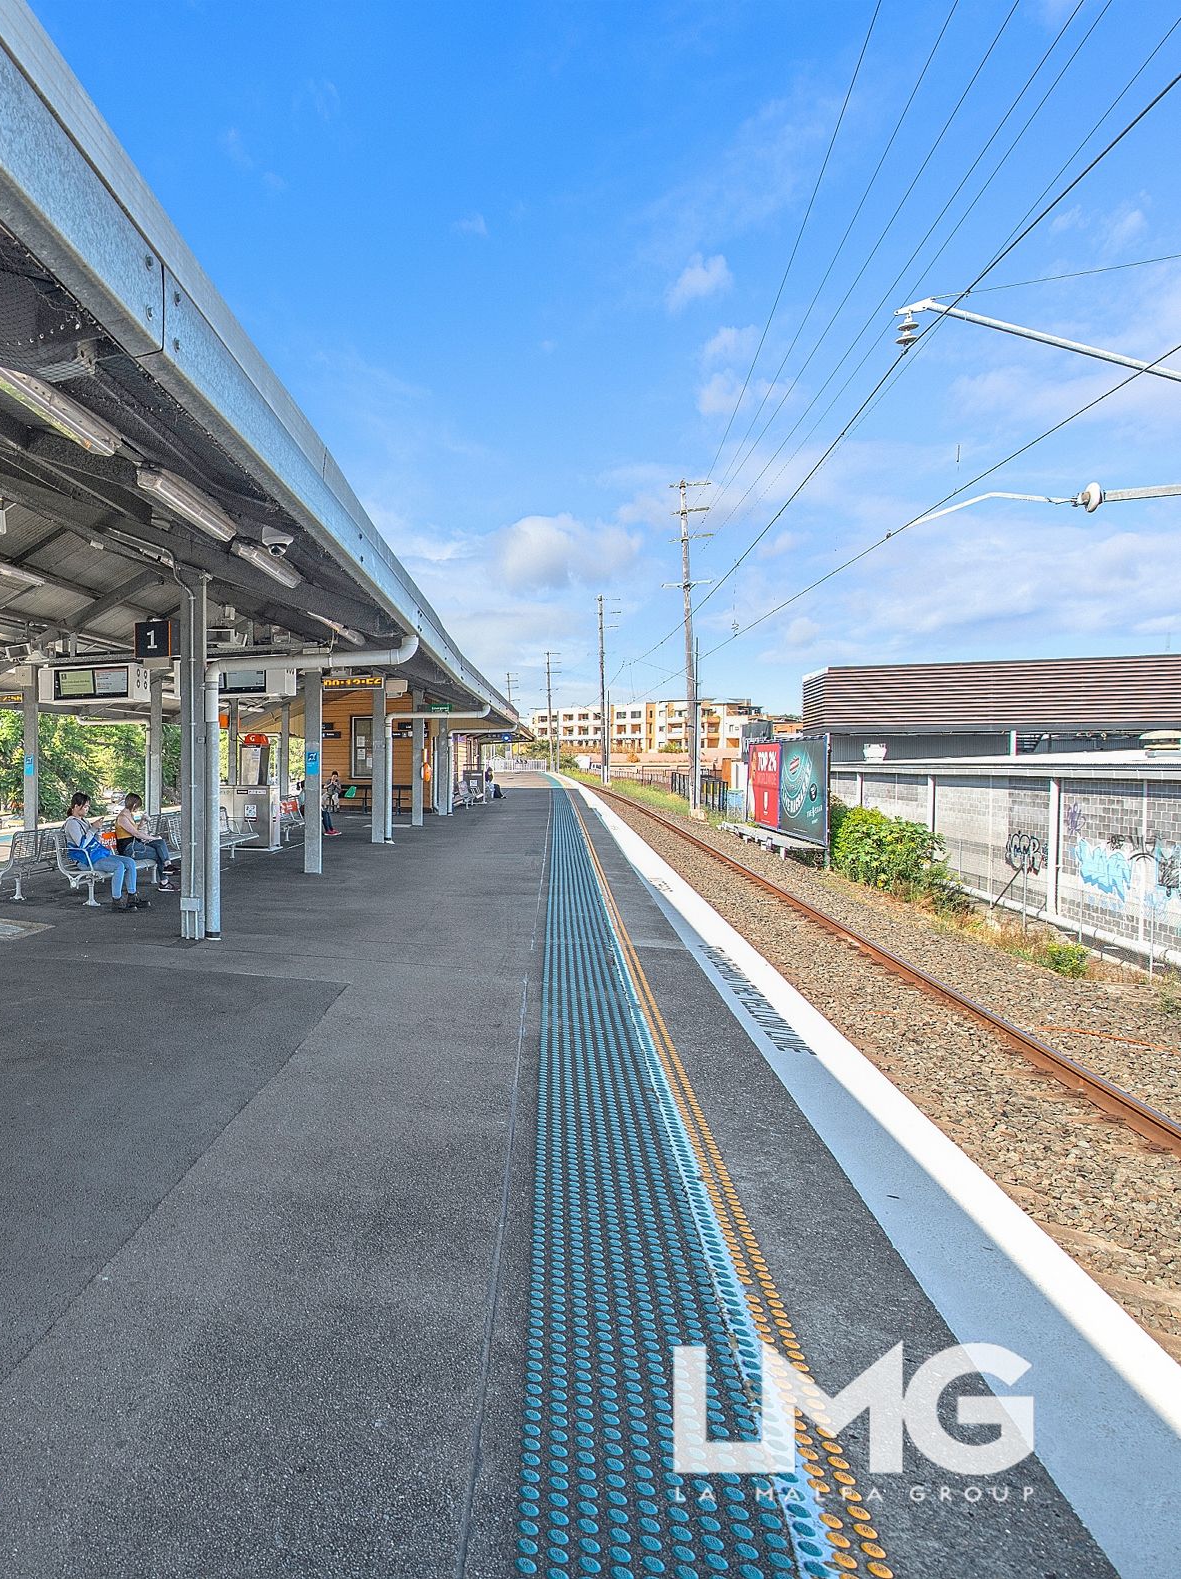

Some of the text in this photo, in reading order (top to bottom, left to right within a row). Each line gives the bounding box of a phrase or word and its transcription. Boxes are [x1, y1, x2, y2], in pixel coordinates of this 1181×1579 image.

[146, 629, 158, 649] 1
[727, 982, 766, 999] THE
[737, 996, 796, 1033] YELLOW
[763, 1030, 818, 1056] LINE
